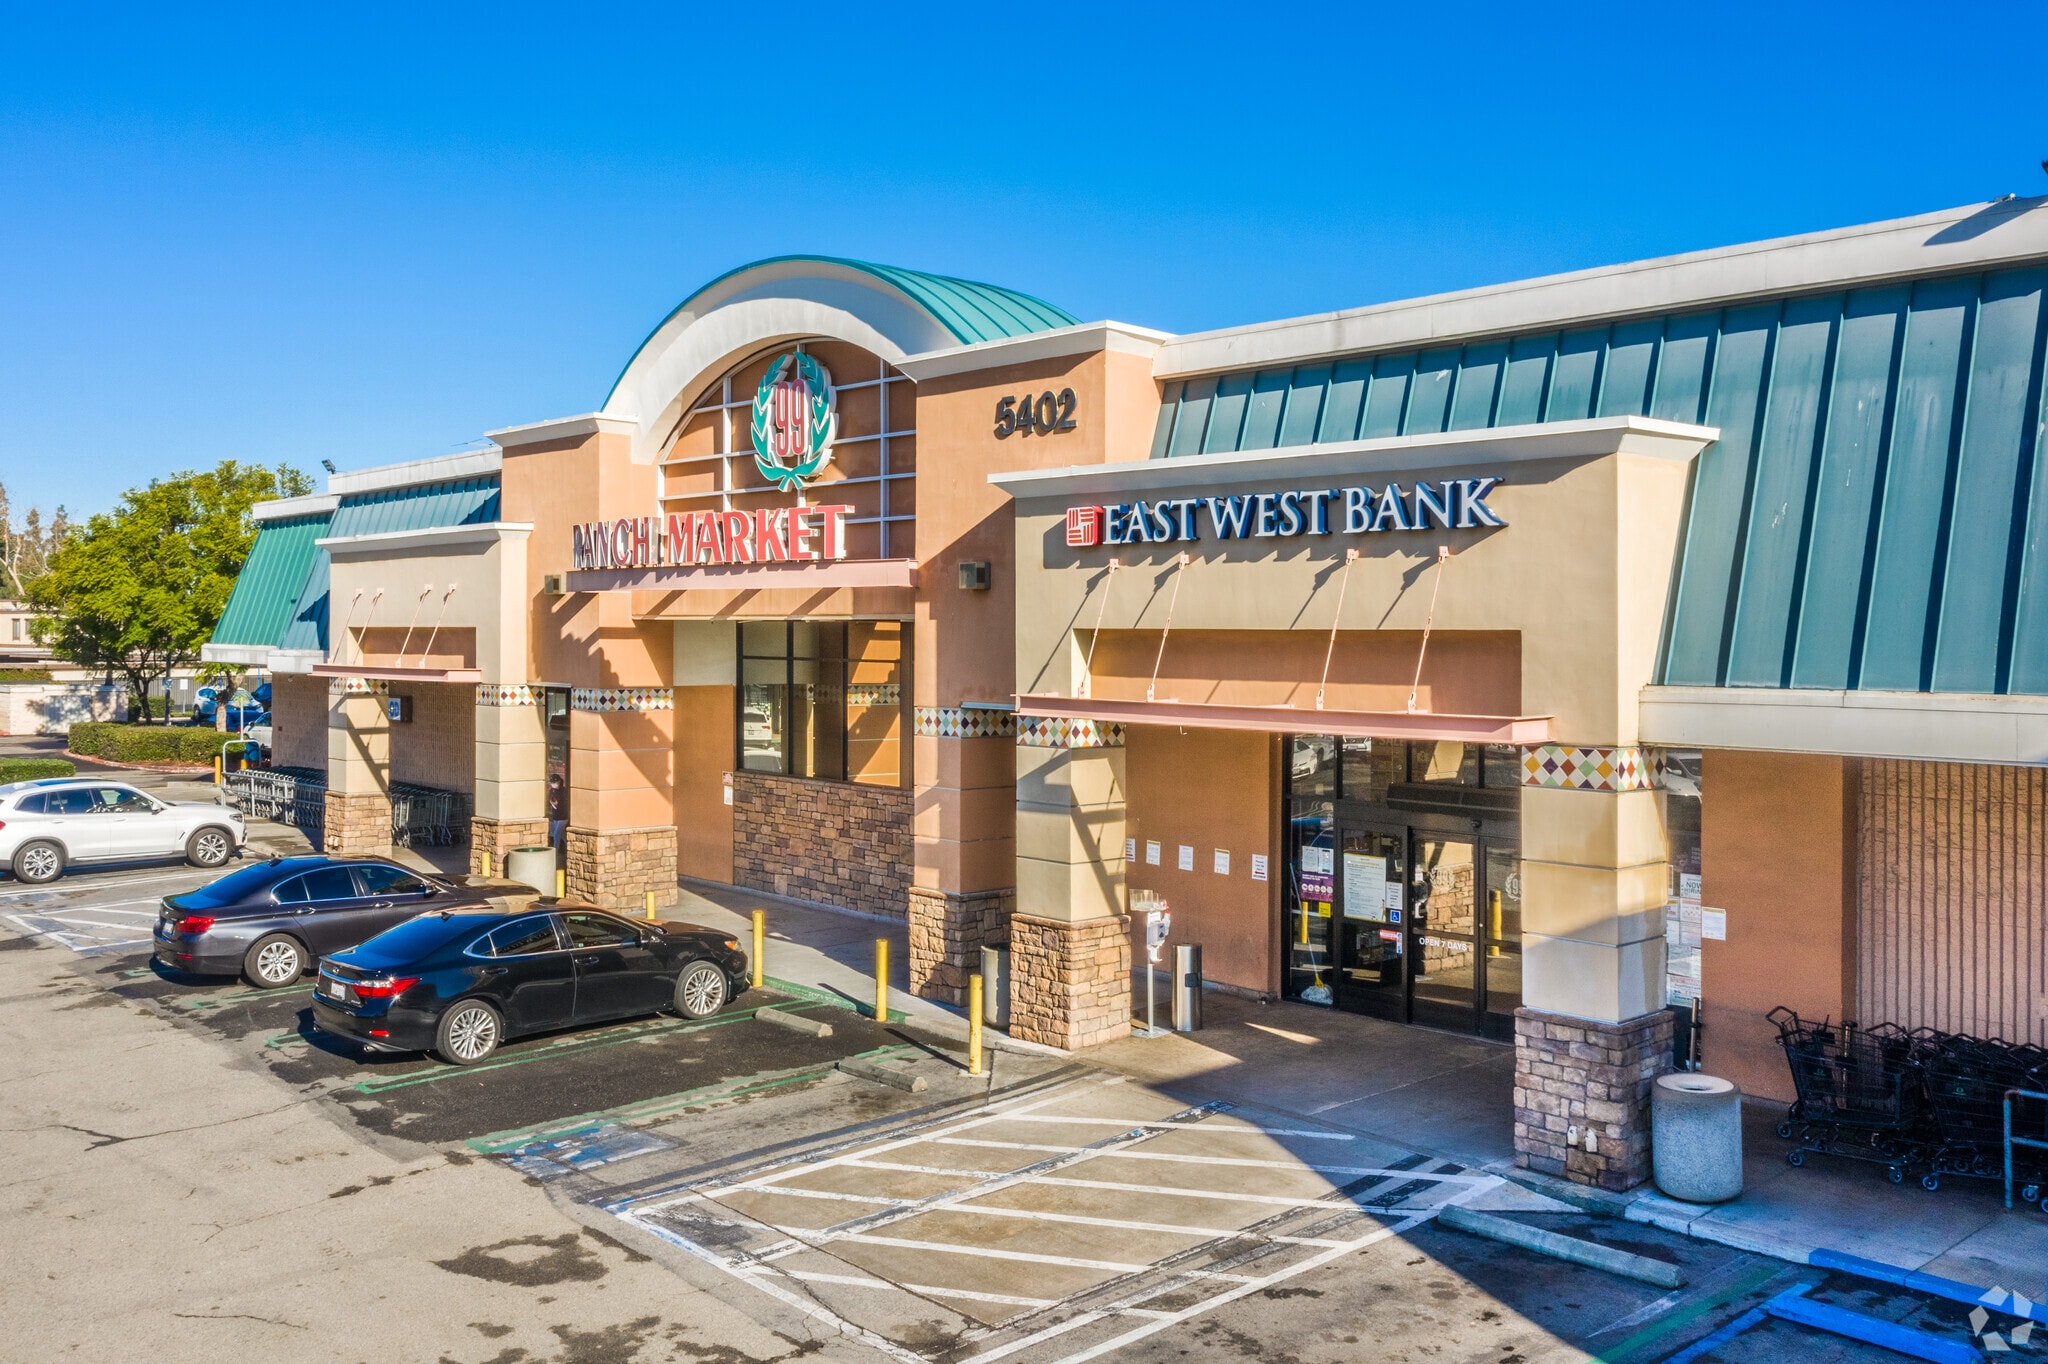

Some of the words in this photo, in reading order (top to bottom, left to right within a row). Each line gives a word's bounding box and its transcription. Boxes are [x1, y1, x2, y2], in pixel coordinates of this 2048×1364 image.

[775, 379, 806, 457] 99
[999, 387, 1078, 436] 5402
[573, 517, 655, 568] RANCH
[668, 505, 851, 563] MARKET
[1102, 498, 1204, 546] EAST
[1205, 489, 1339, 541] WEST
[1342, 477, 1508, 534] BANK
[1418, 937, 1440, 947] OPEN
[1441, 940, 1446, 948] 7
[1447, 941, 1468, 951] DAYS
